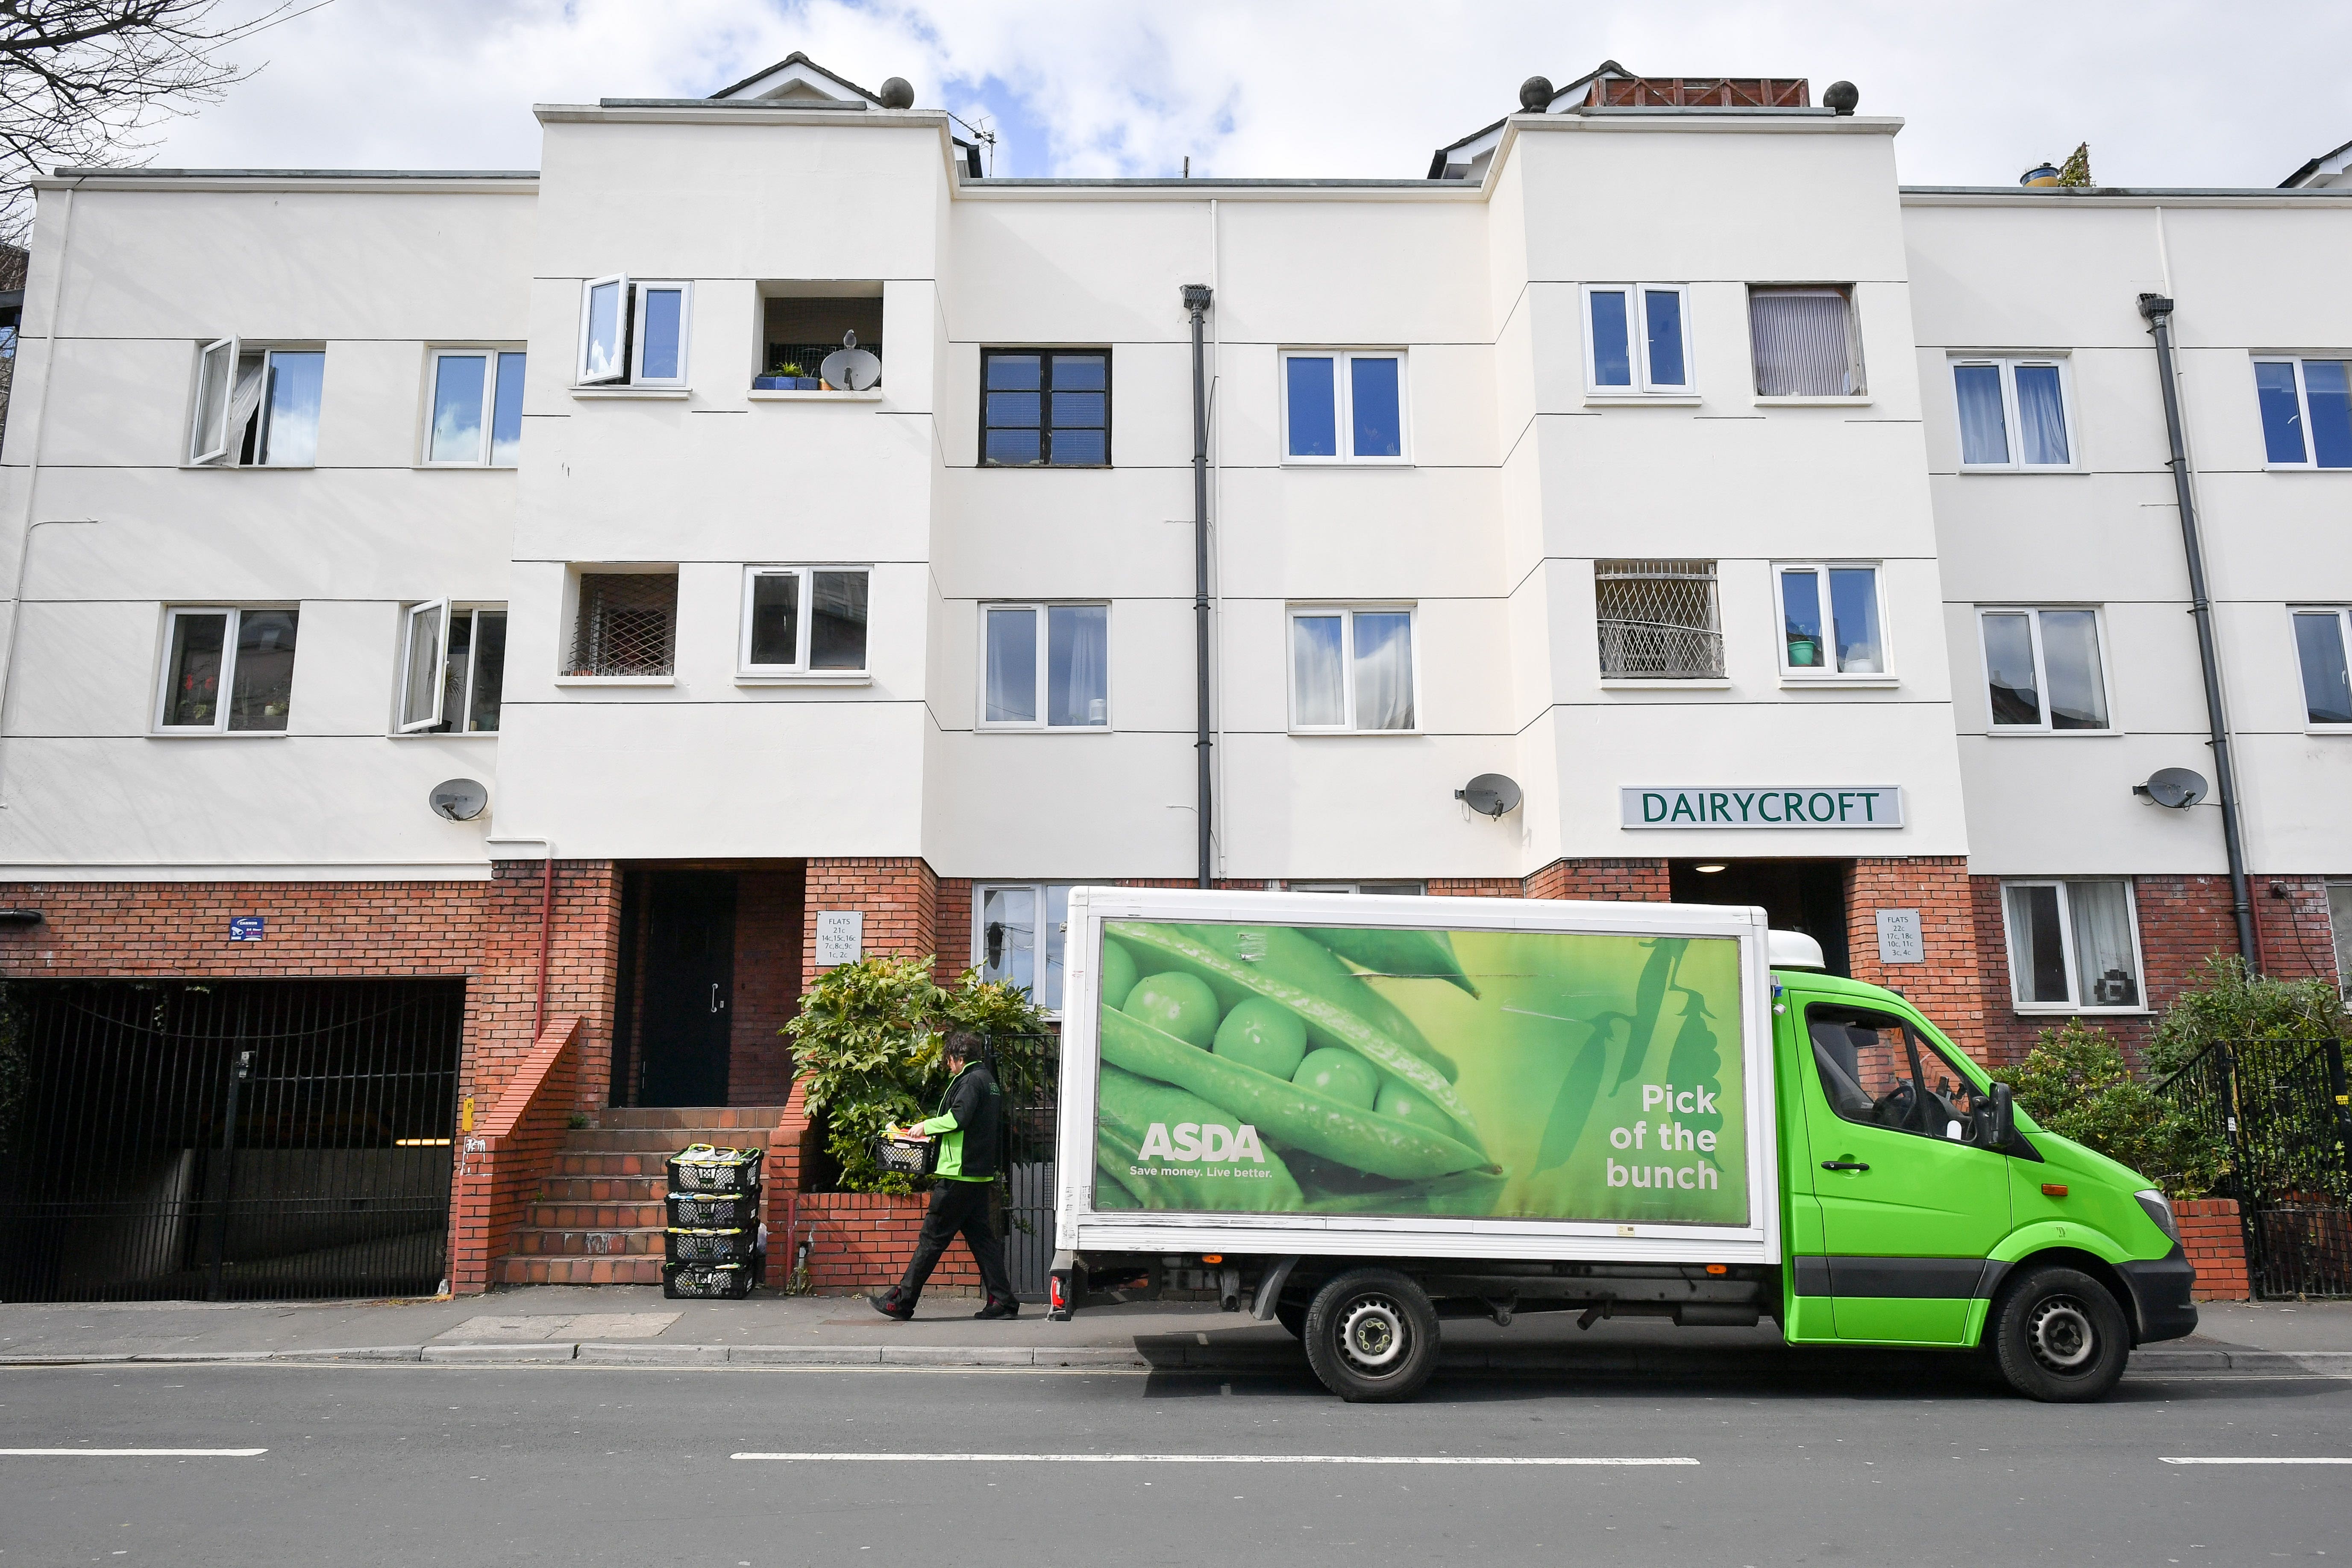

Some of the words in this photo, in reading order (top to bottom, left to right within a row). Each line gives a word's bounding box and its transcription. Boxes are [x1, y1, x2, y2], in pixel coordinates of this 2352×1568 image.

[1643, 793, 1879, 822] DAIRYCROFT
[1643, 1084, 1717, 1114] Pick
[1138, 1122, 1265, 1163] ASDA
[1610, 1121, 1647, 1149] of
[1658, 1122, 1717, 1151] the
[1130, 1166, 1157, 1176] Save
[1161, 1167, 1203, 1178] money.
[1207, 1168, 1230, 1177] Live
[1234, 1168, 1272, 1178] better.
[1607, 1158, 1718, 1189] bunch
